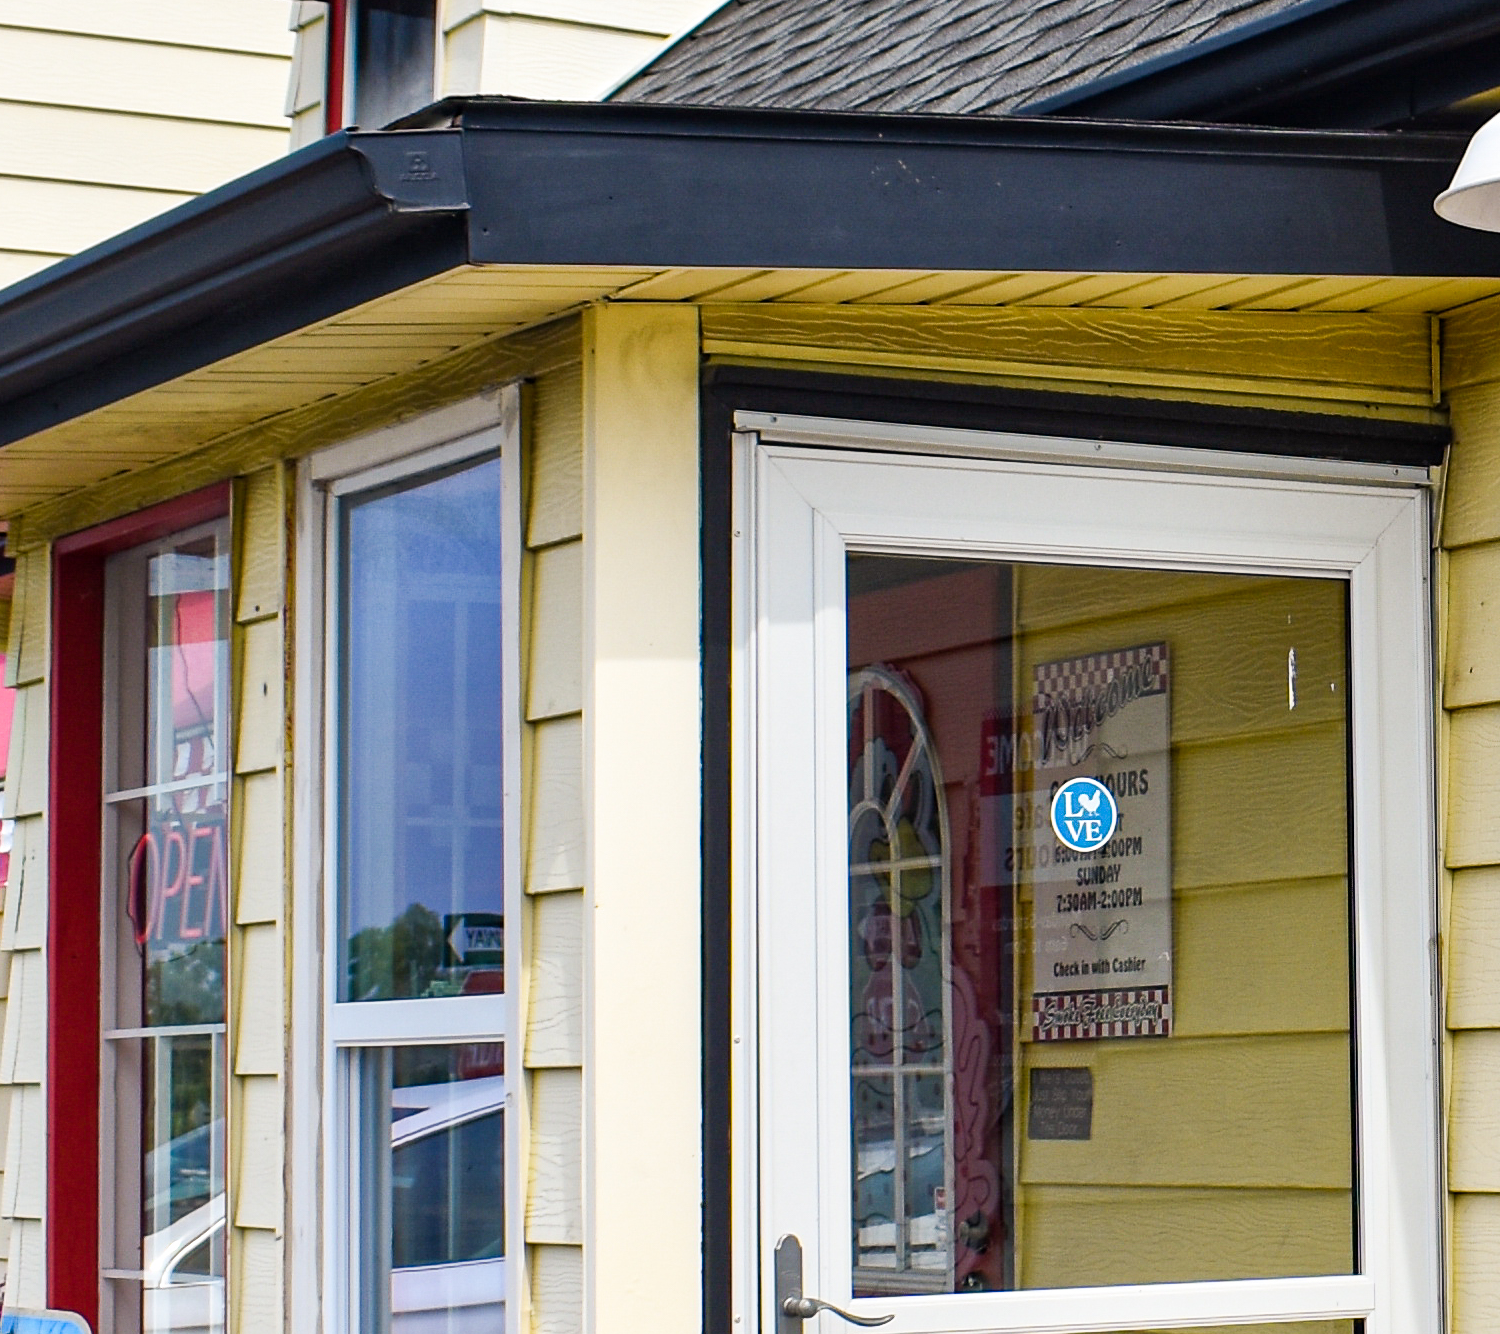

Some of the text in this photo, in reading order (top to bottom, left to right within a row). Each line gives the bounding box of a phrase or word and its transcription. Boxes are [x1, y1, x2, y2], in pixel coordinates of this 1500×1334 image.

[1042, 654, 1154, 765] Welcome
[1076, 863, 1121, 886] SUNDAY
[1056, 887, 1143, 913] 7:30AM-2:00PM
[1053, 957, 1147, 977] Check in with Cashier
